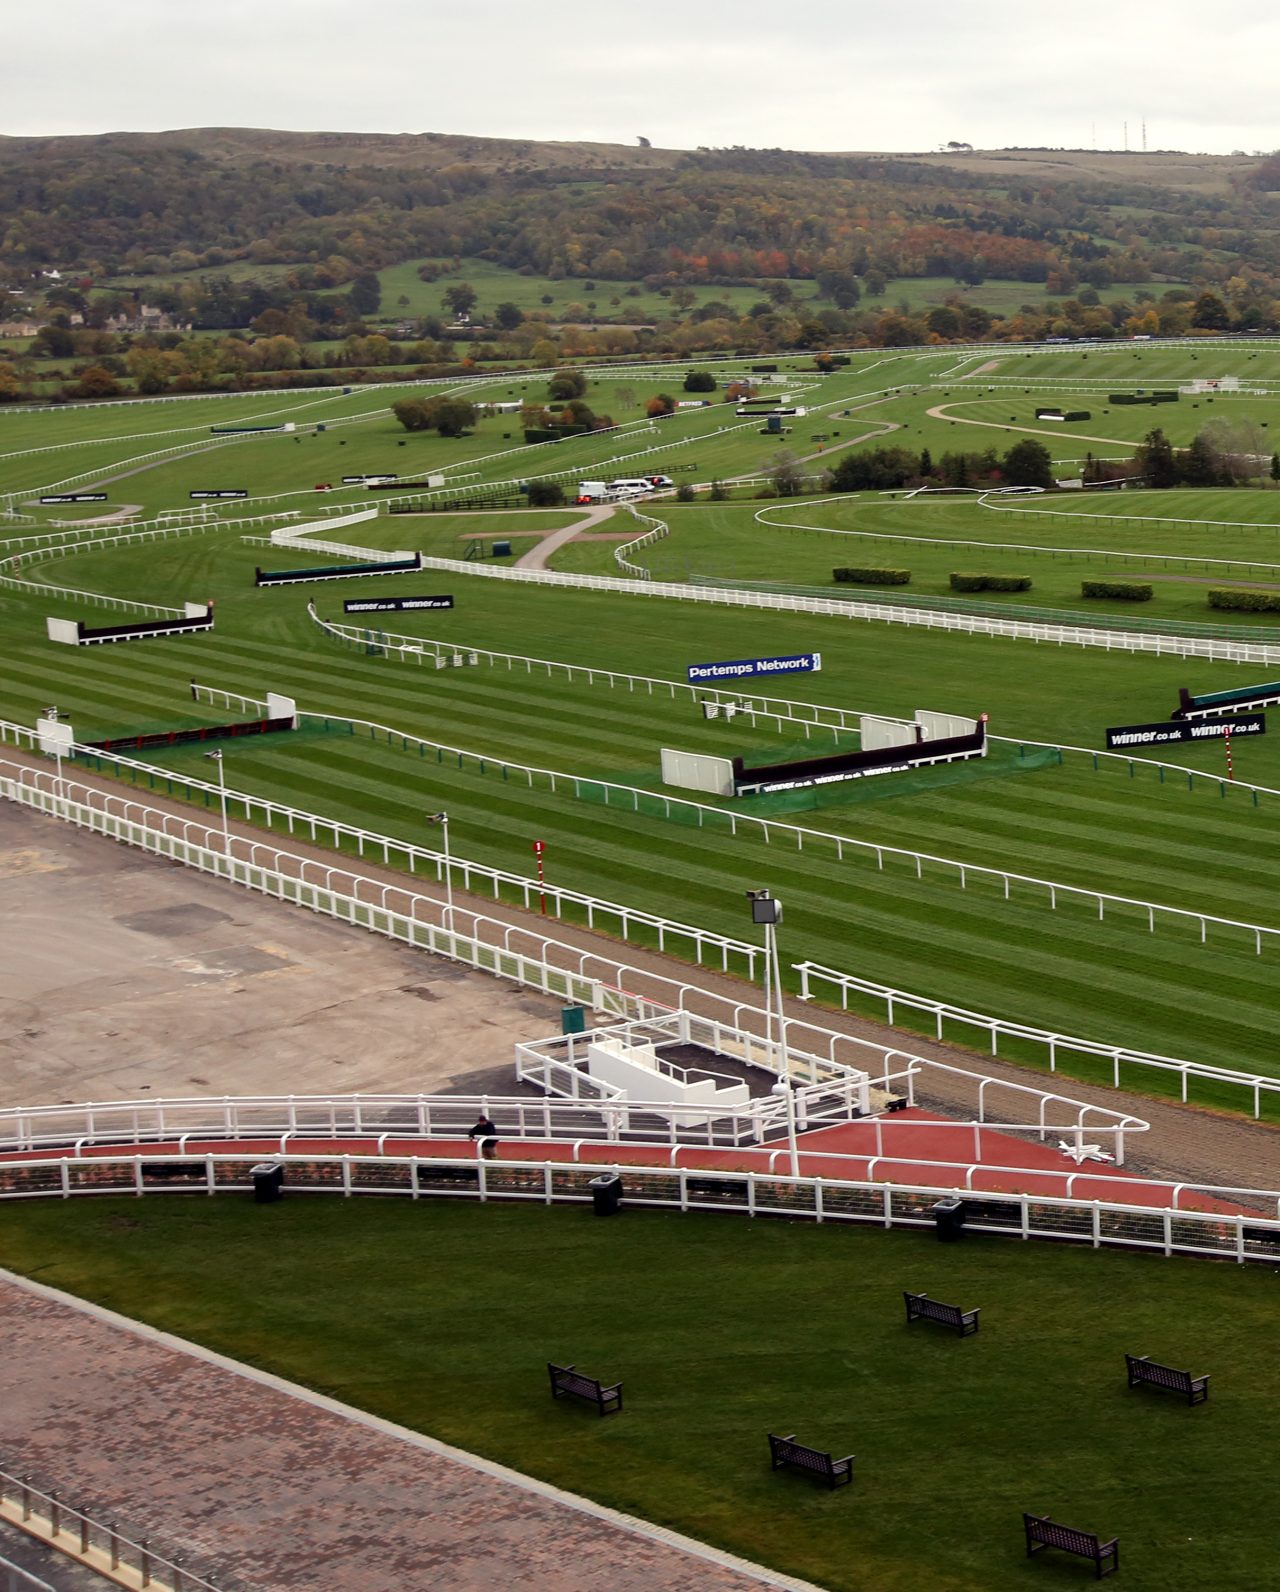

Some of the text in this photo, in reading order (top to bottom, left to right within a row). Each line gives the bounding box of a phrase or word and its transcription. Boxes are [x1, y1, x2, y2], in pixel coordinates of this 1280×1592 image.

[689, 657, 810, 678] Pertemps Network
[1111, 729, 1182, 746] winner.co.uk
